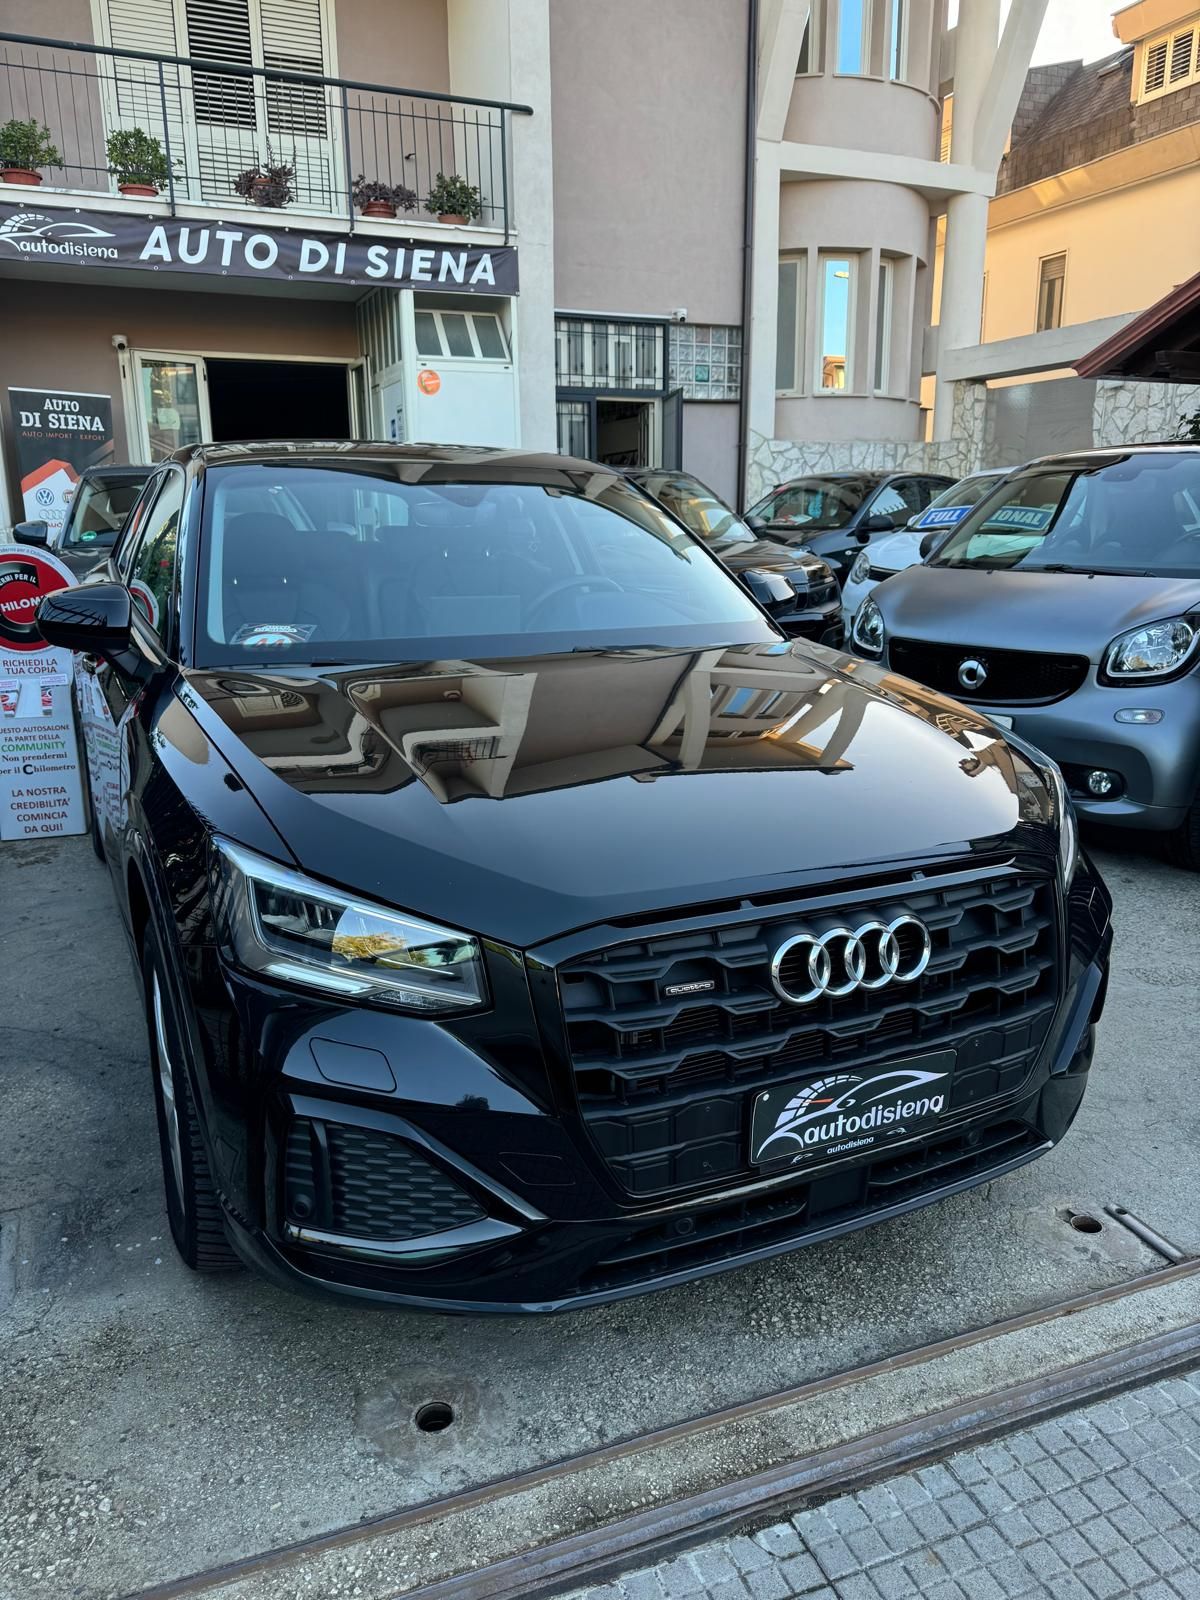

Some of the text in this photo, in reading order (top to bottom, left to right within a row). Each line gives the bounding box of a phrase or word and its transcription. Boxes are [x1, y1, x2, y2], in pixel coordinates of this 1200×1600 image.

[20, 239, 118, 259] autodisiena
[139, 225, 496, 286] AUTO DI SIENA
[43, 398, 80, 412] AUTO
[19, 411, 105, 432] DI SIENA
[21, 430, 43, 438] AUTO
[45, 431, 73, 439] IMPORT
[925, 508, 962, 524] FULL
[14, 572, 29, 581] PER
[30, 575, 37, 584] IL
[3, 658, 58, 667] RICHIEDI LA
[5, 666, 57, 675] TUA COPIA
[22, 724, 70, 733] AUTOSALONE
[4, 735, 14, 743] FA
[15, 735, 37, 743] PARTE
[1, 741, 66, 752] COMMUNITY
[2, 751, 68, 763] Non prendermi
[14, 766, 20, 774] il
[22, 763, 76, 776] Chilometro
[11, 786, 67, 798] LA NOSTRA
[10, 797, 71, 810] CREDIBILITA'
[16, 811, 68, 822] COMINCIA
[24, 823, 63, 834] DA QUI!
[670, 983, 712, 994] quattro
[803, 1094, 945, 1145] autodisiena
[826, 1135, 875, 1154] autodisiena
